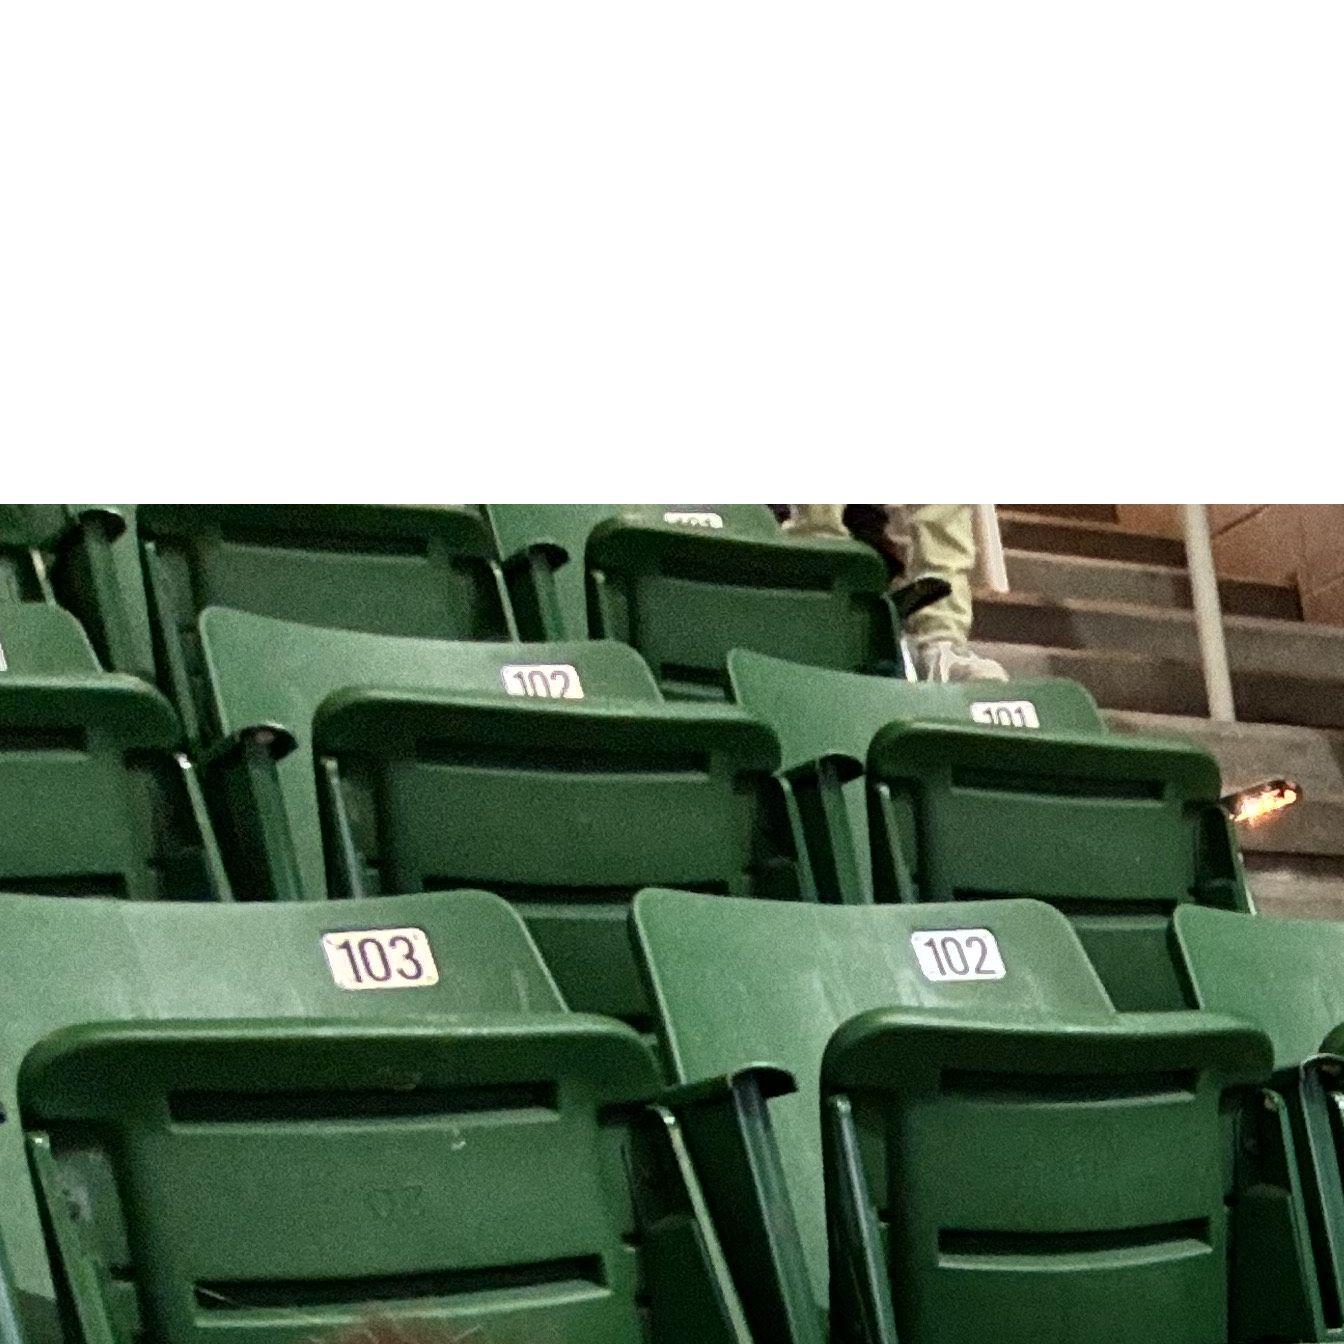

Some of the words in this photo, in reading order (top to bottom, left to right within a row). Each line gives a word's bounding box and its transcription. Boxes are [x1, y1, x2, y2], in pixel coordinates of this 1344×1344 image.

[514, 670, 571, 699] 102
[981, 706, 1027, 728] 101
[337, 934, 425, 983] 103
[922, 934, 996, 978] 102
